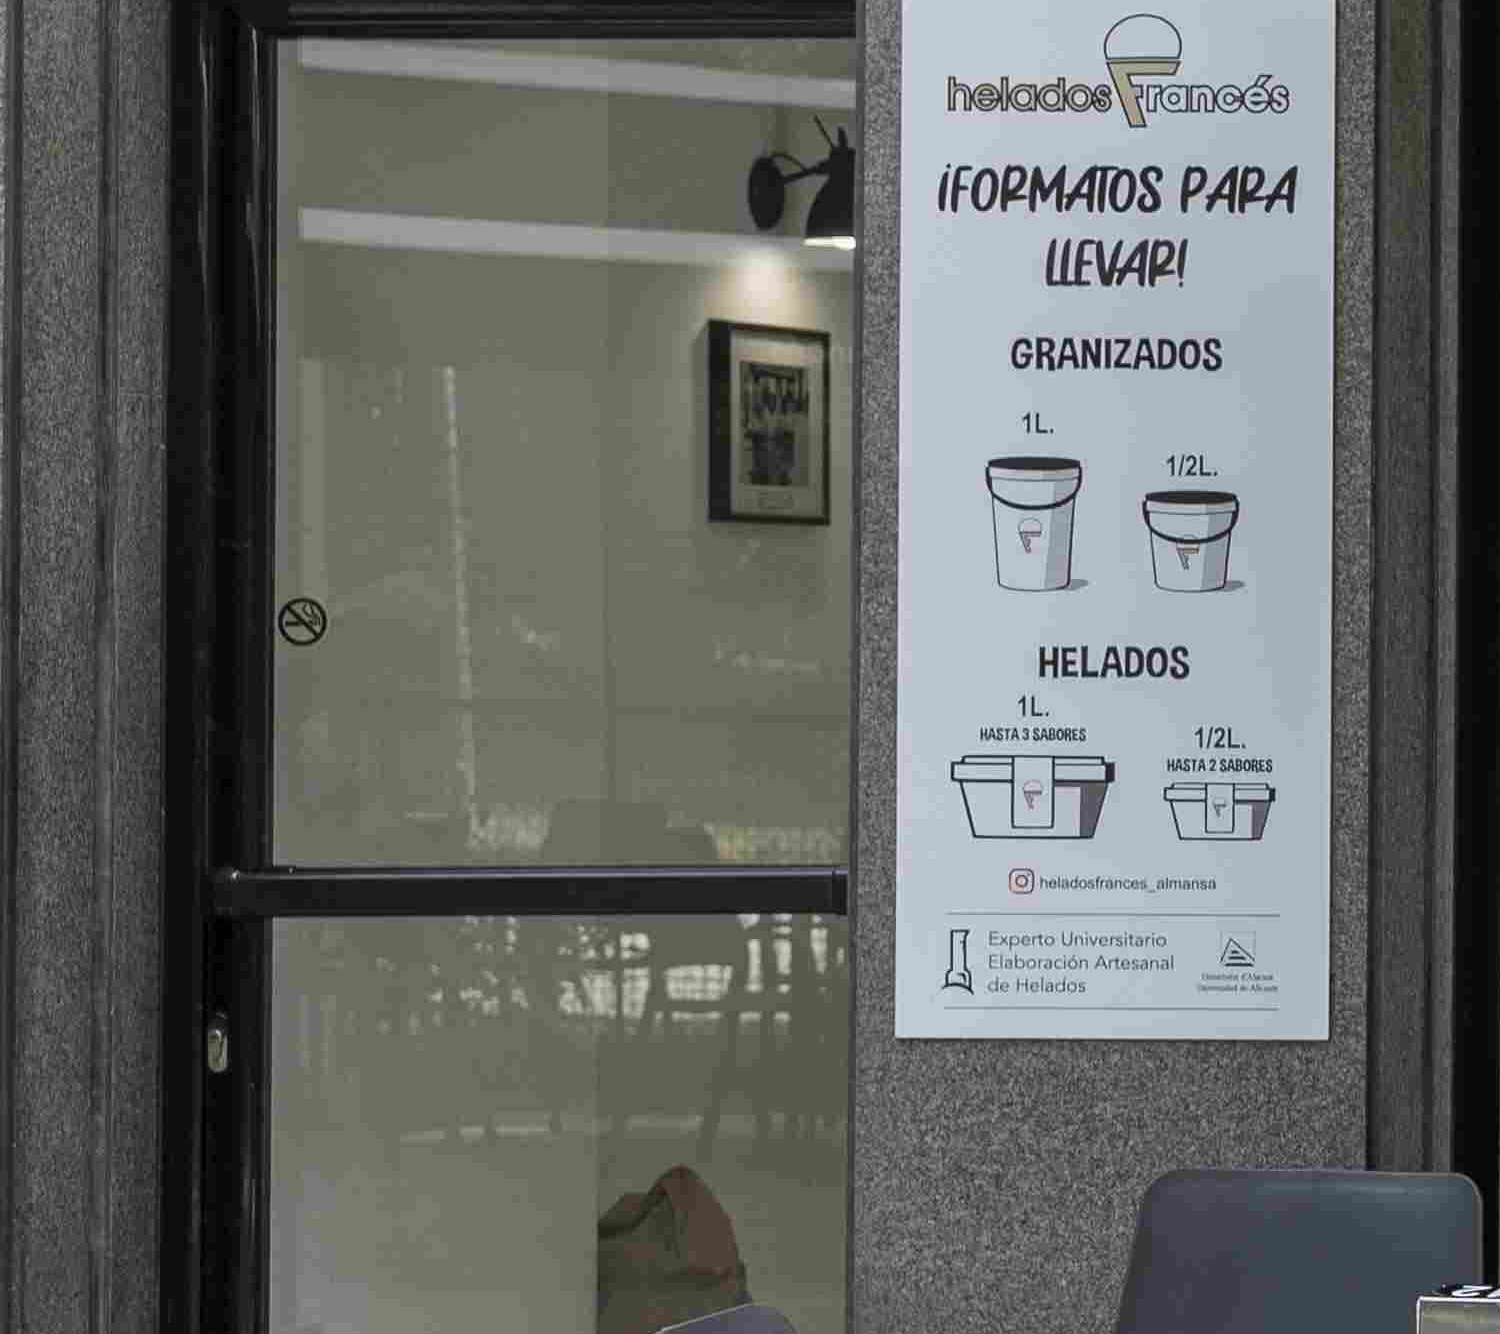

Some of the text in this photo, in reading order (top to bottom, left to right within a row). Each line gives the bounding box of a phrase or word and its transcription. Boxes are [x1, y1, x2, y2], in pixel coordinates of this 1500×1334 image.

[946, 60, 1291, 128] helados Francés
[1180, 164, 1299, 215] PARA
[1045, 237, 1189, 289] LLEVAR!
[1010, 336, 1223, 372] GRANIZADOS
[1021, 412, 1054, 435] 1L.
[1165, 453, 1219, 477] 1/2L.
[1038, 645, 1191, 680] HELADOS
[1017, 694, 1050, 718] 1L.
[979, 726, 1087, 743] HASTA 3 SABORES
[1194, 726, 1247, 750] 1/2L.
[1166, 754, 1273, 774] HASTA 2 SABORES
[1039, 874, 1217, 894] heladosfrances_almansa
[988, 930, 1168, 951] Experto Universitario
[988, 953, 1175, 972] Elaboración Artesanal
[987, 975, 1086, 995] de Helados
